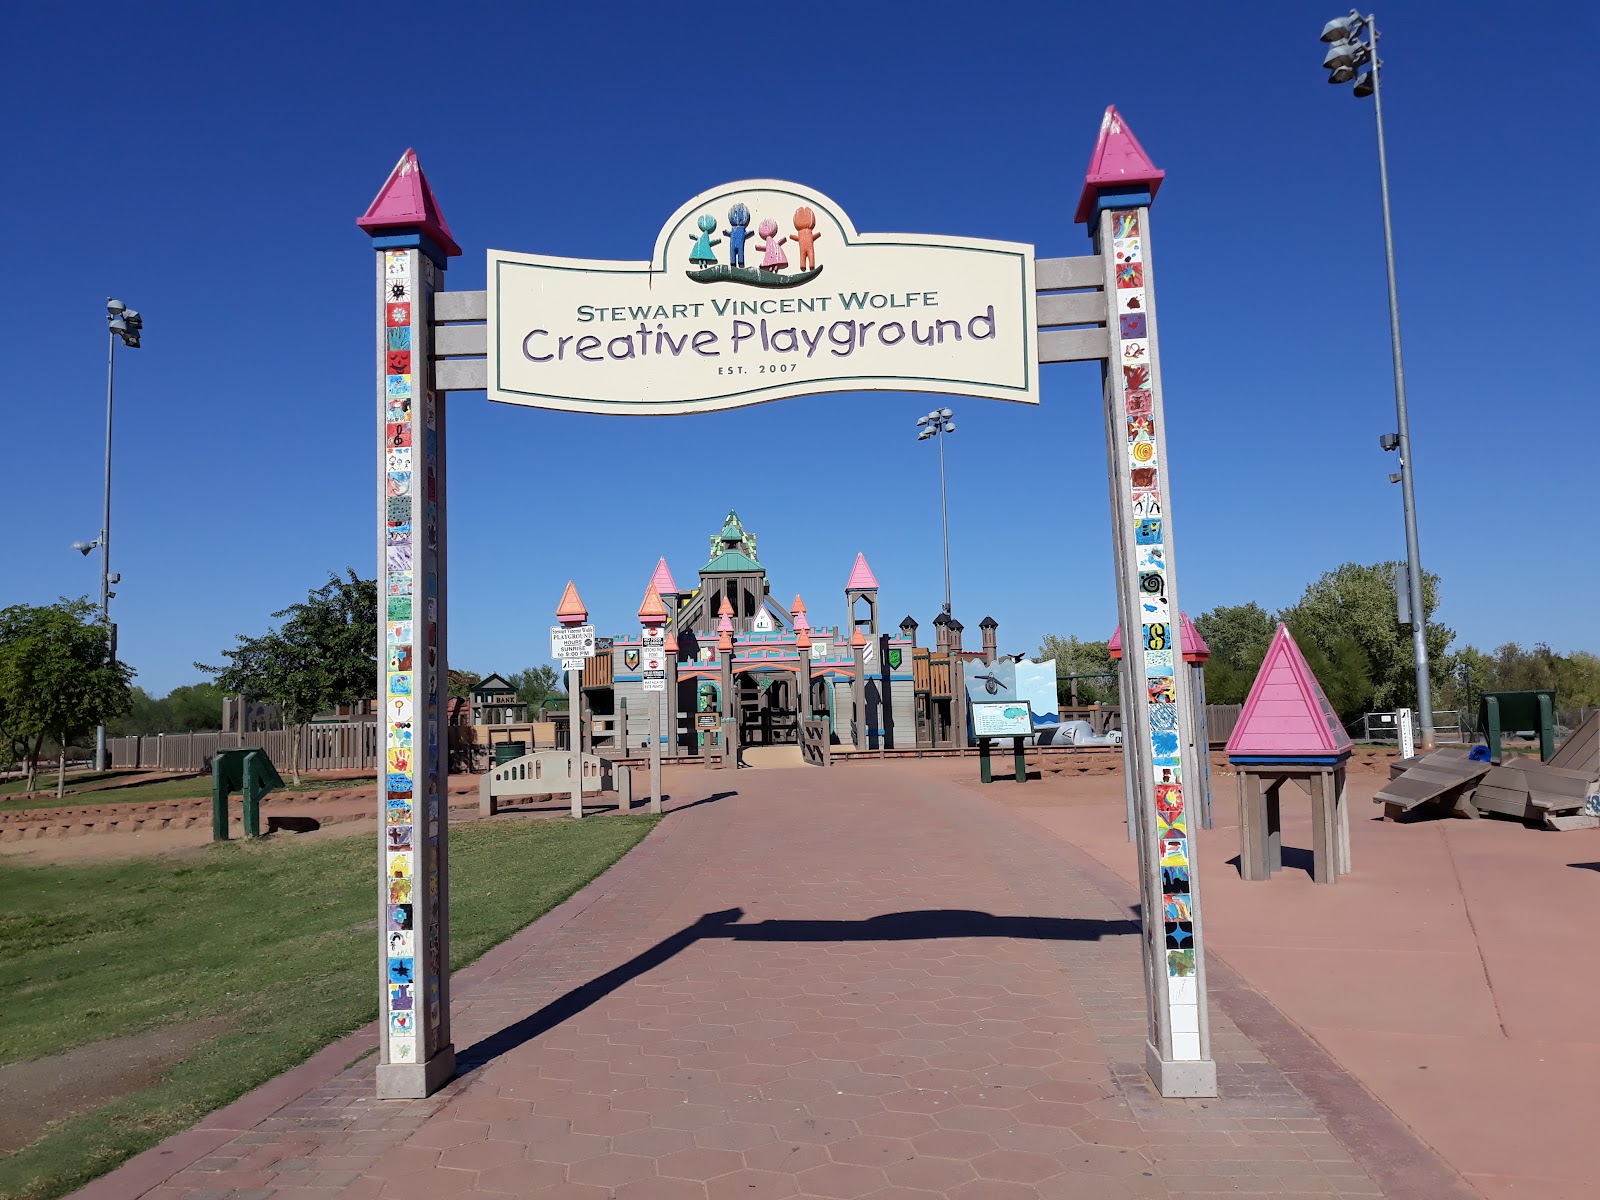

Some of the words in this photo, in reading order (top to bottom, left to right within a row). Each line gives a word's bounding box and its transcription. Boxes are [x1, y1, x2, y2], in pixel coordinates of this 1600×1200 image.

[577, 303, 705, 322] STEWART
[710, 297, 832, 317] VINCENT
[838, 292, 938, 311] WOLFE
[523, 323, 721, 363] Creative
[731, 305, 996, 358] Playground
[718, 366, 747, 376] EST.
[758, 363, 797, 374] 2007
